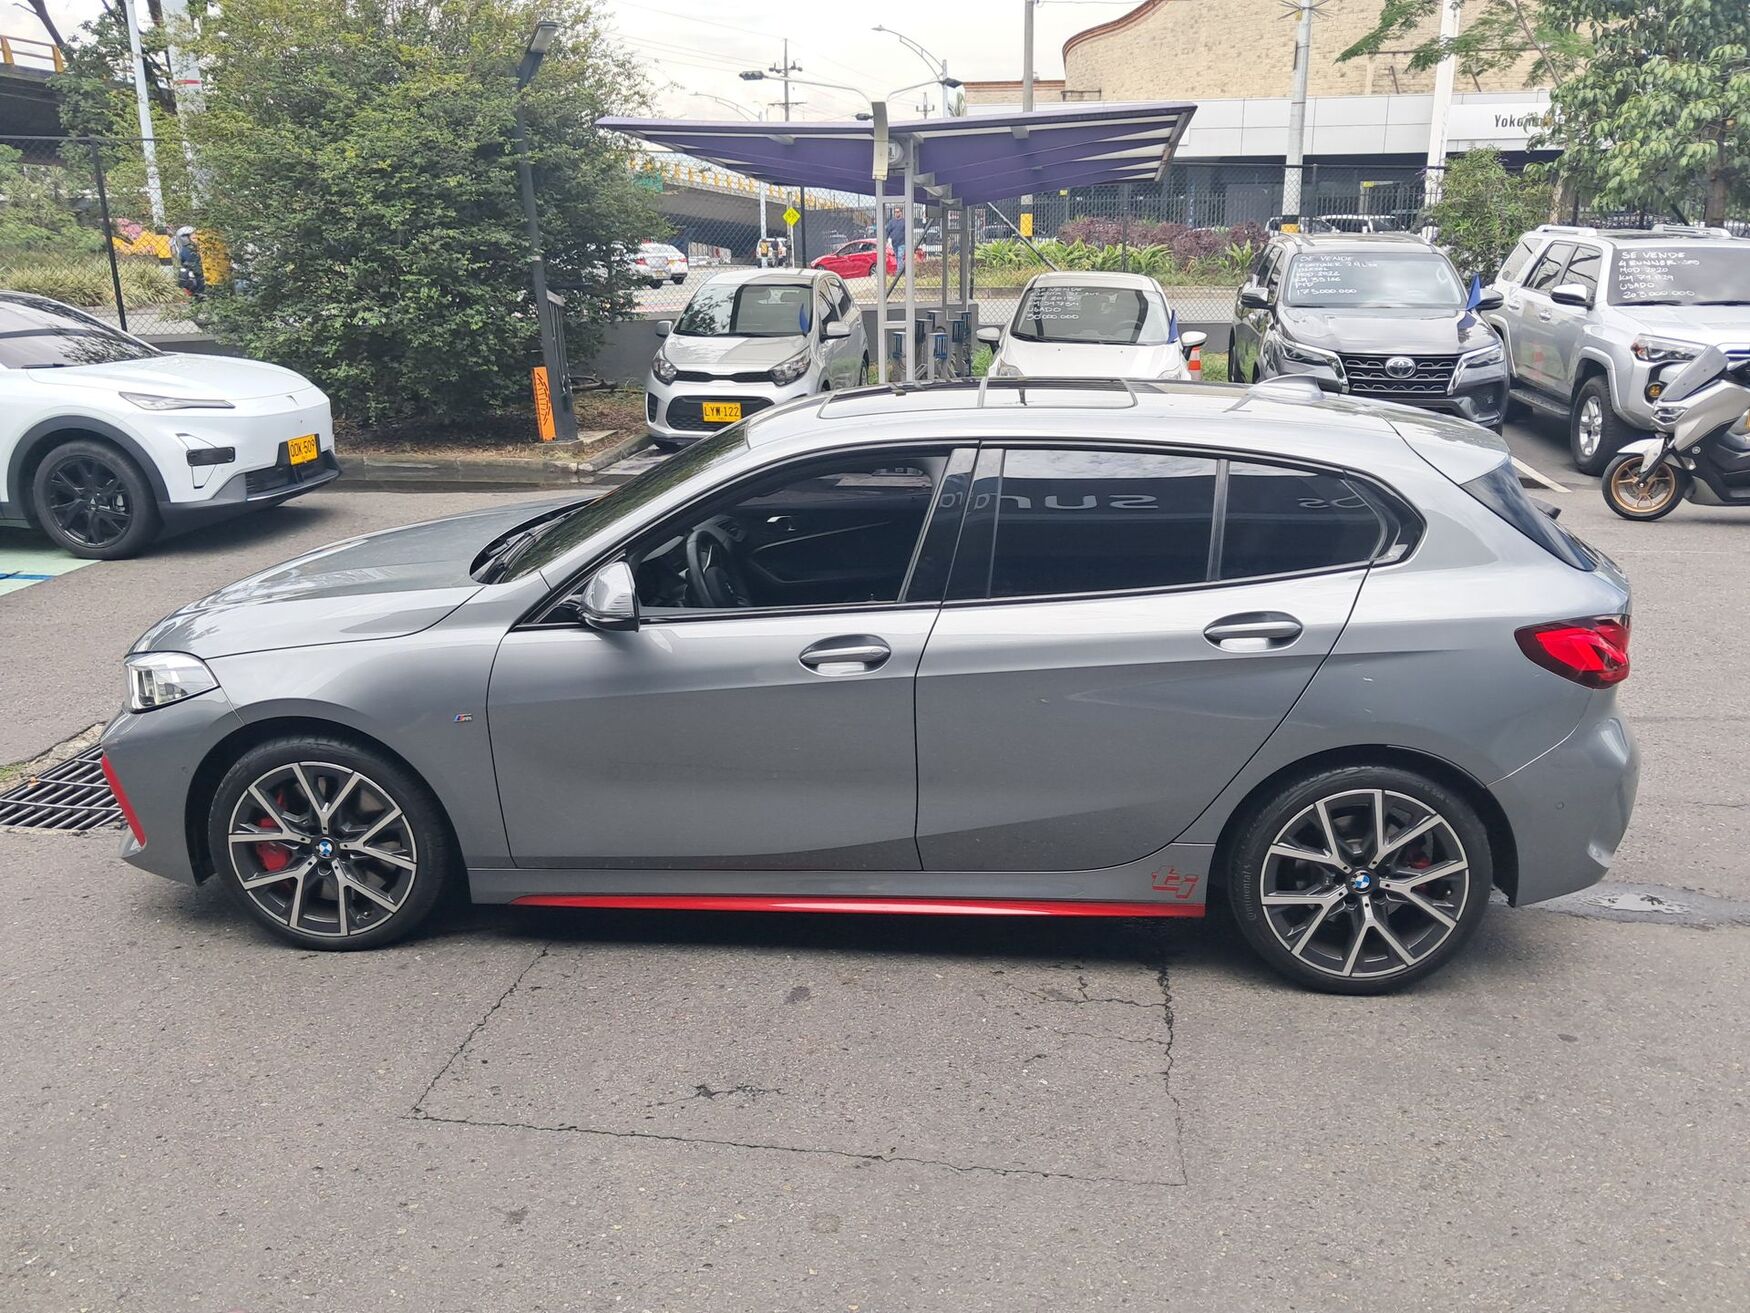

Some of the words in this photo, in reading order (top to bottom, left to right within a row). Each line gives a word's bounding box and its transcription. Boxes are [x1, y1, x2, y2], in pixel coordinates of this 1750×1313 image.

[1621, 251, 1637, 259] SE
[1642, 251, 1686, 259] VENDE
[1619, 282, 1655, 290] USADO
